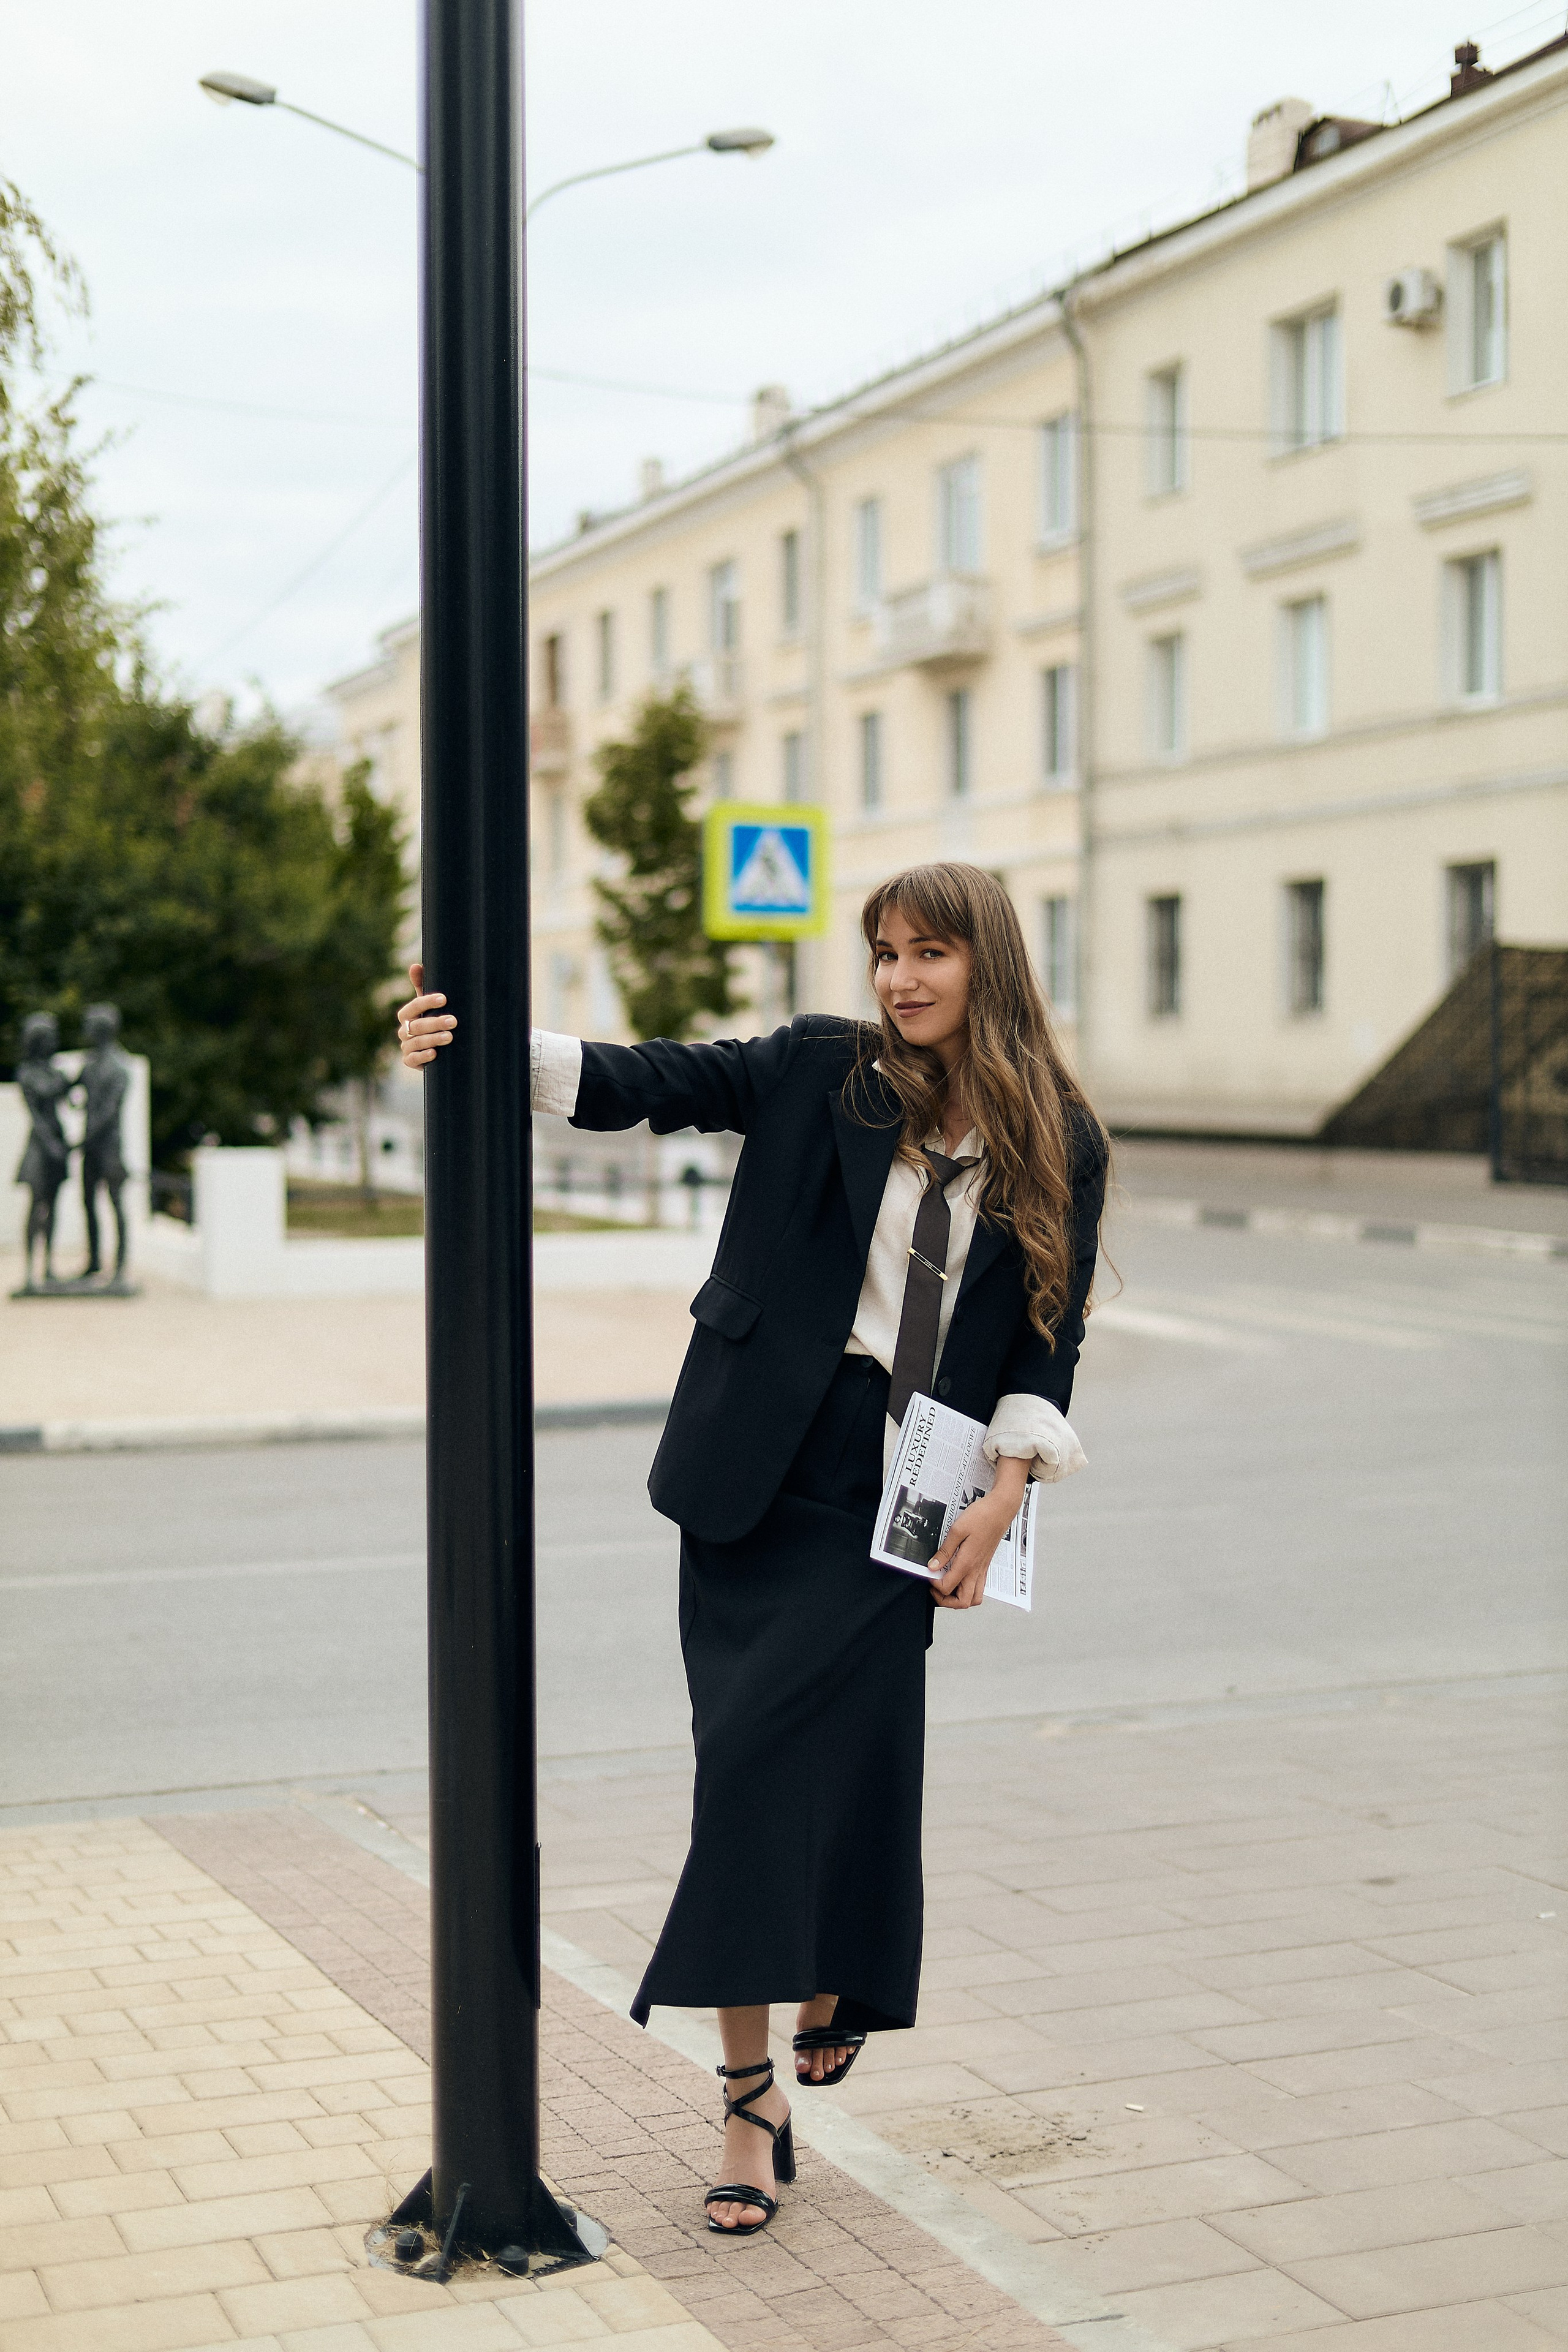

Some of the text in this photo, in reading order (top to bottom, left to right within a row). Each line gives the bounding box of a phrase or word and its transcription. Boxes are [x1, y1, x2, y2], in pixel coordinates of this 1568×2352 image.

[906, 1414, 927, 1471] LUXURY
[910, 1406, 936, 1487] REDEFINED
[945, 1497, 957, 1534] FASHION
[954, 1469, 965, 1497] UNITE
[962, 1457, 968, 1470] AT
[965, 1426, 976, 1457] LOEWE
